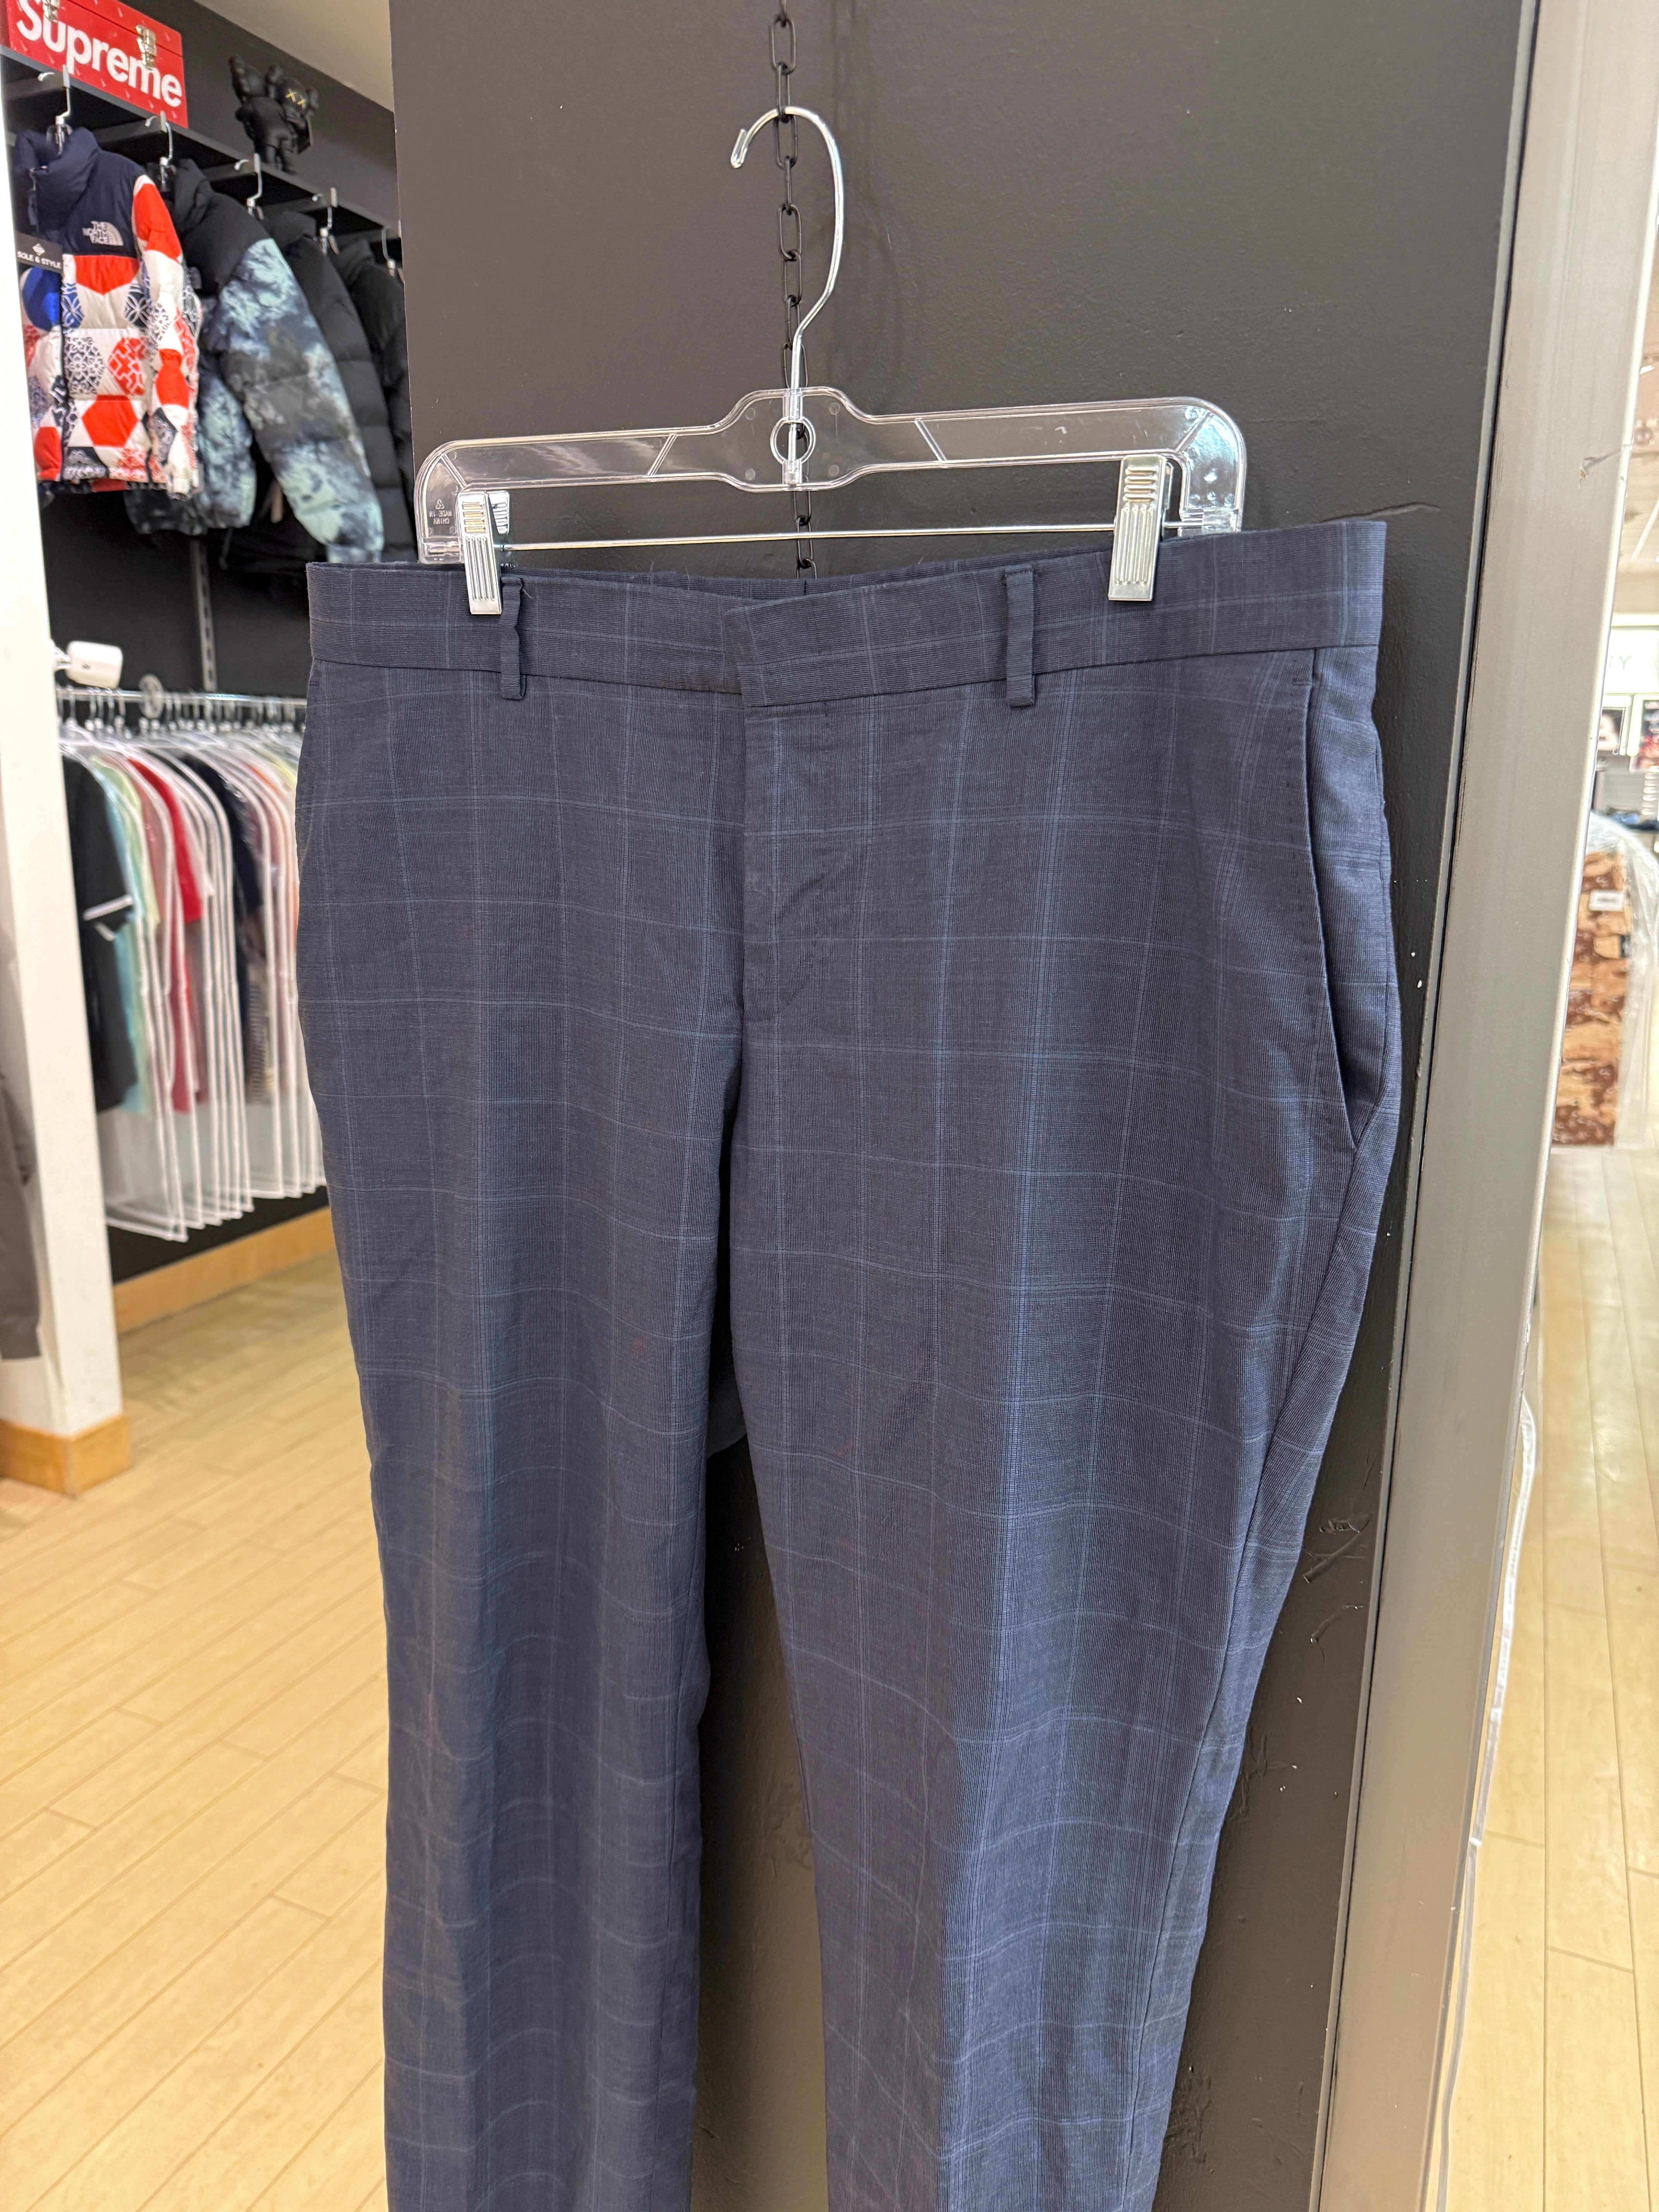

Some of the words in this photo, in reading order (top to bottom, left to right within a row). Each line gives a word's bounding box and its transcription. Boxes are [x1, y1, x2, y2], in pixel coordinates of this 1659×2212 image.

[16, 0, 182, 107] Supreme
[91, 221, 106, 230] THE
[89, 235, 110, 244] FACE
[17, 251, 34, 262] SOLE
[41, 258, 62, 269] STYLE
